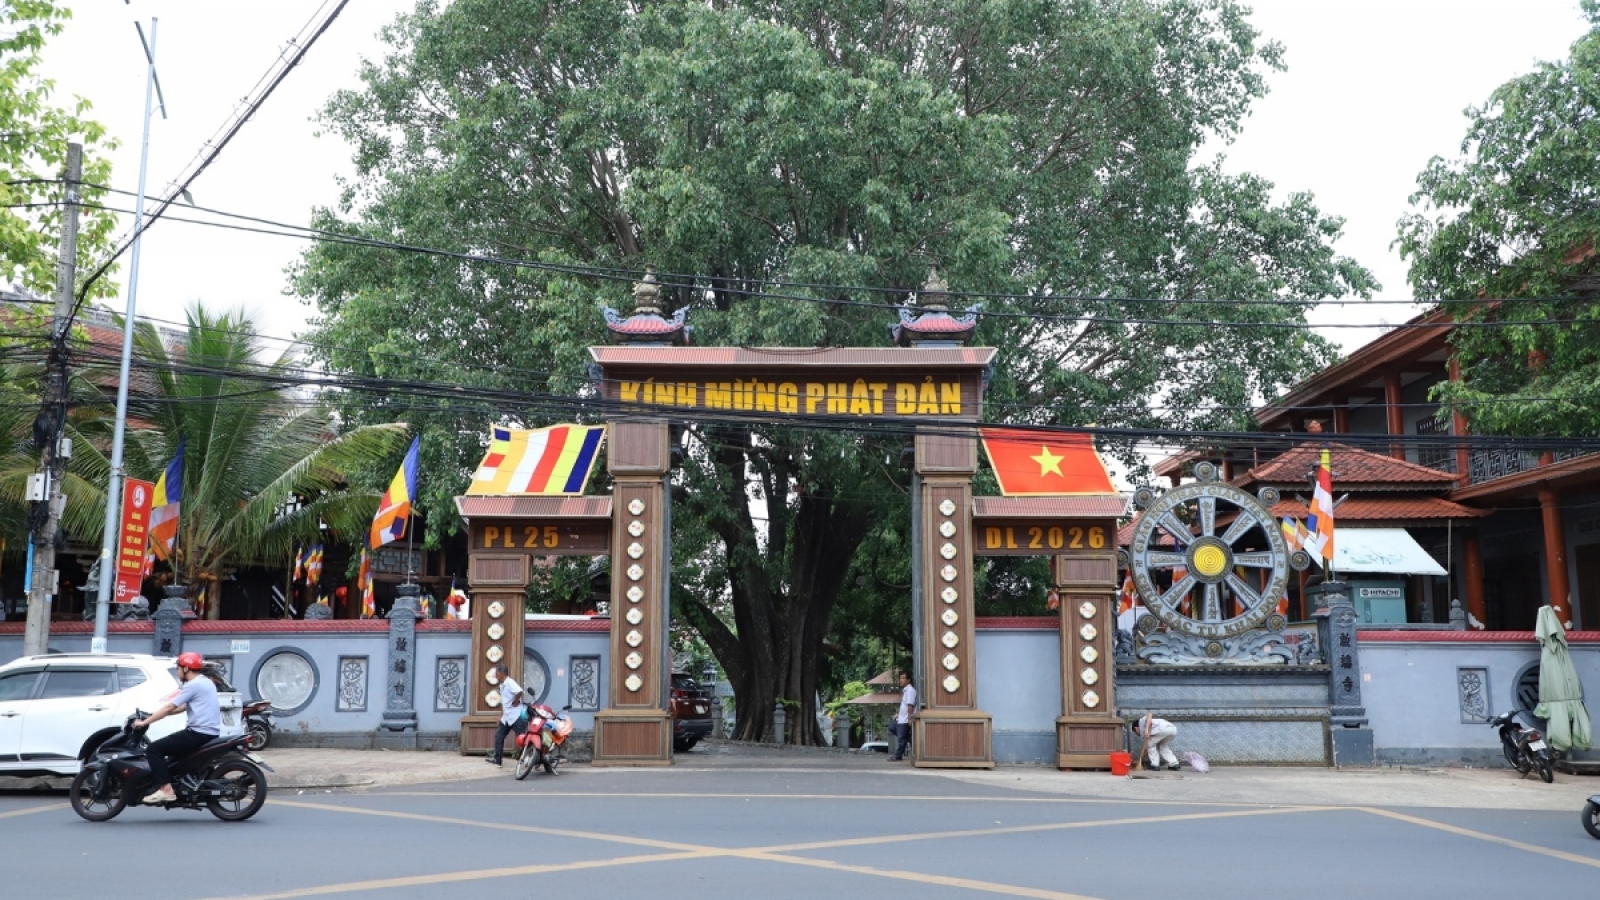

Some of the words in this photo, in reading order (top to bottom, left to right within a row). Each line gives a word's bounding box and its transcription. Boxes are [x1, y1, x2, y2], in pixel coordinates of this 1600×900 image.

[619, 377, 697, 411] KÍNH
[704, 377, 798, 413] MỪNG
[806, 379, 888, 417] PHẬT
[894, 375, 961, 414] ĐẢN
[484, 526, 515, 548] PL
[524, 526, 559, 548] 25
[986, 527, 1018, 549] DL
[1028, 526, 1105, 549] 2026
